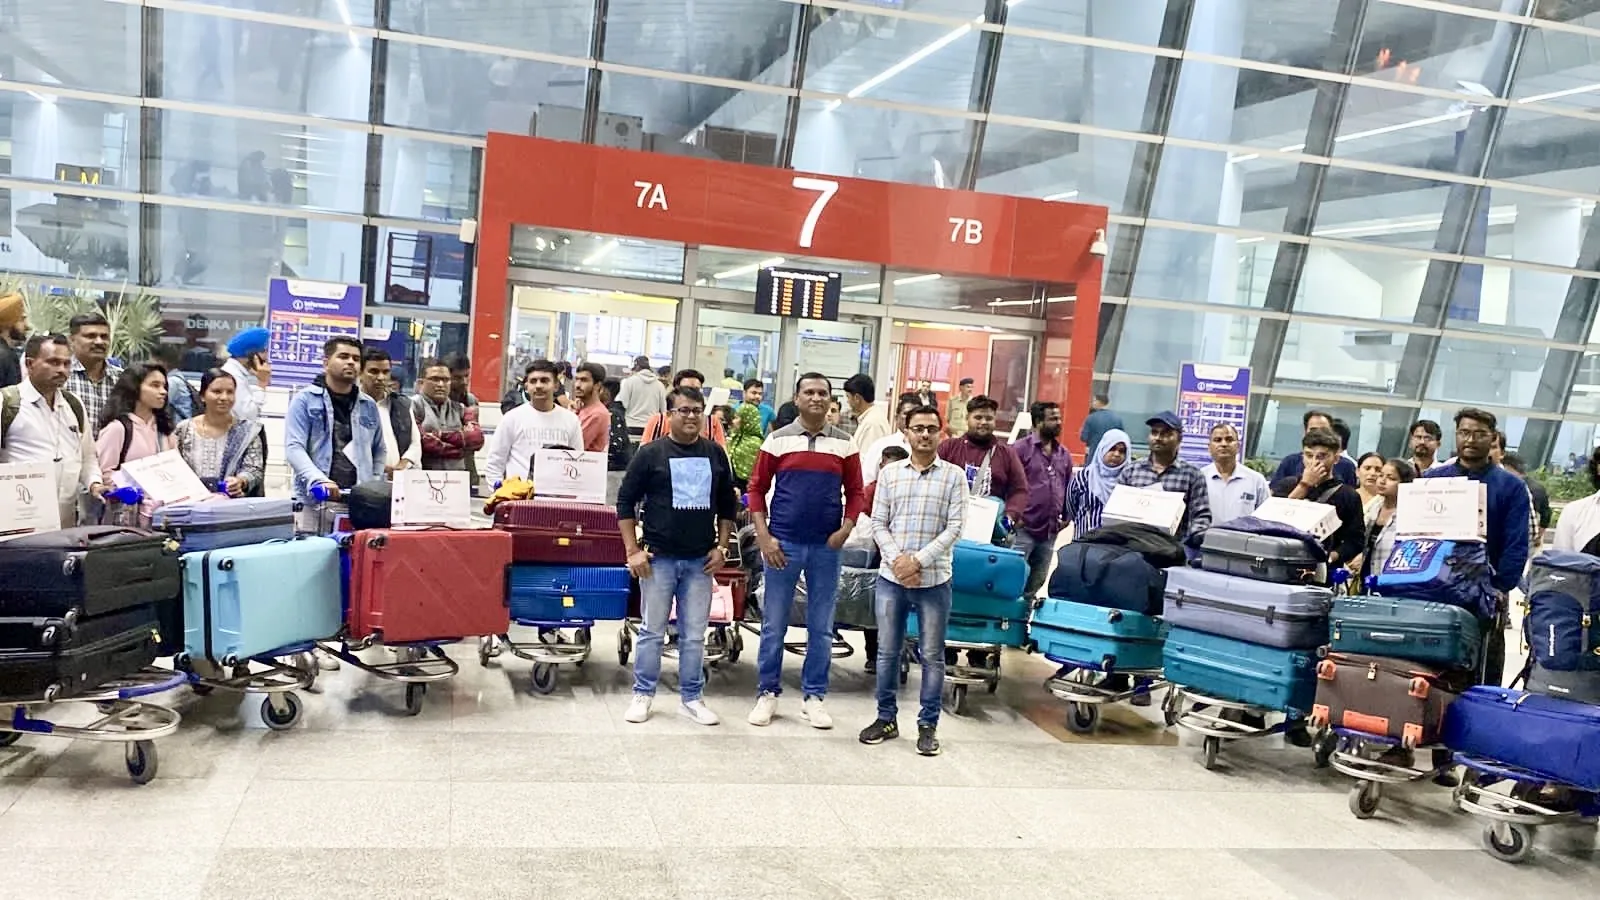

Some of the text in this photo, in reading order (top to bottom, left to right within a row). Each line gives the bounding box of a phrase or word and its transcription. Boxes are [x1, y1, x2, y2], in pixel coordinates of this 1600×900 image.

[634, 181, 668, 209] 7A
[793, 176, 838, 247] 7
[948, 217, 982, 244] 7B
[187, 319, 230, 329] DENKA
